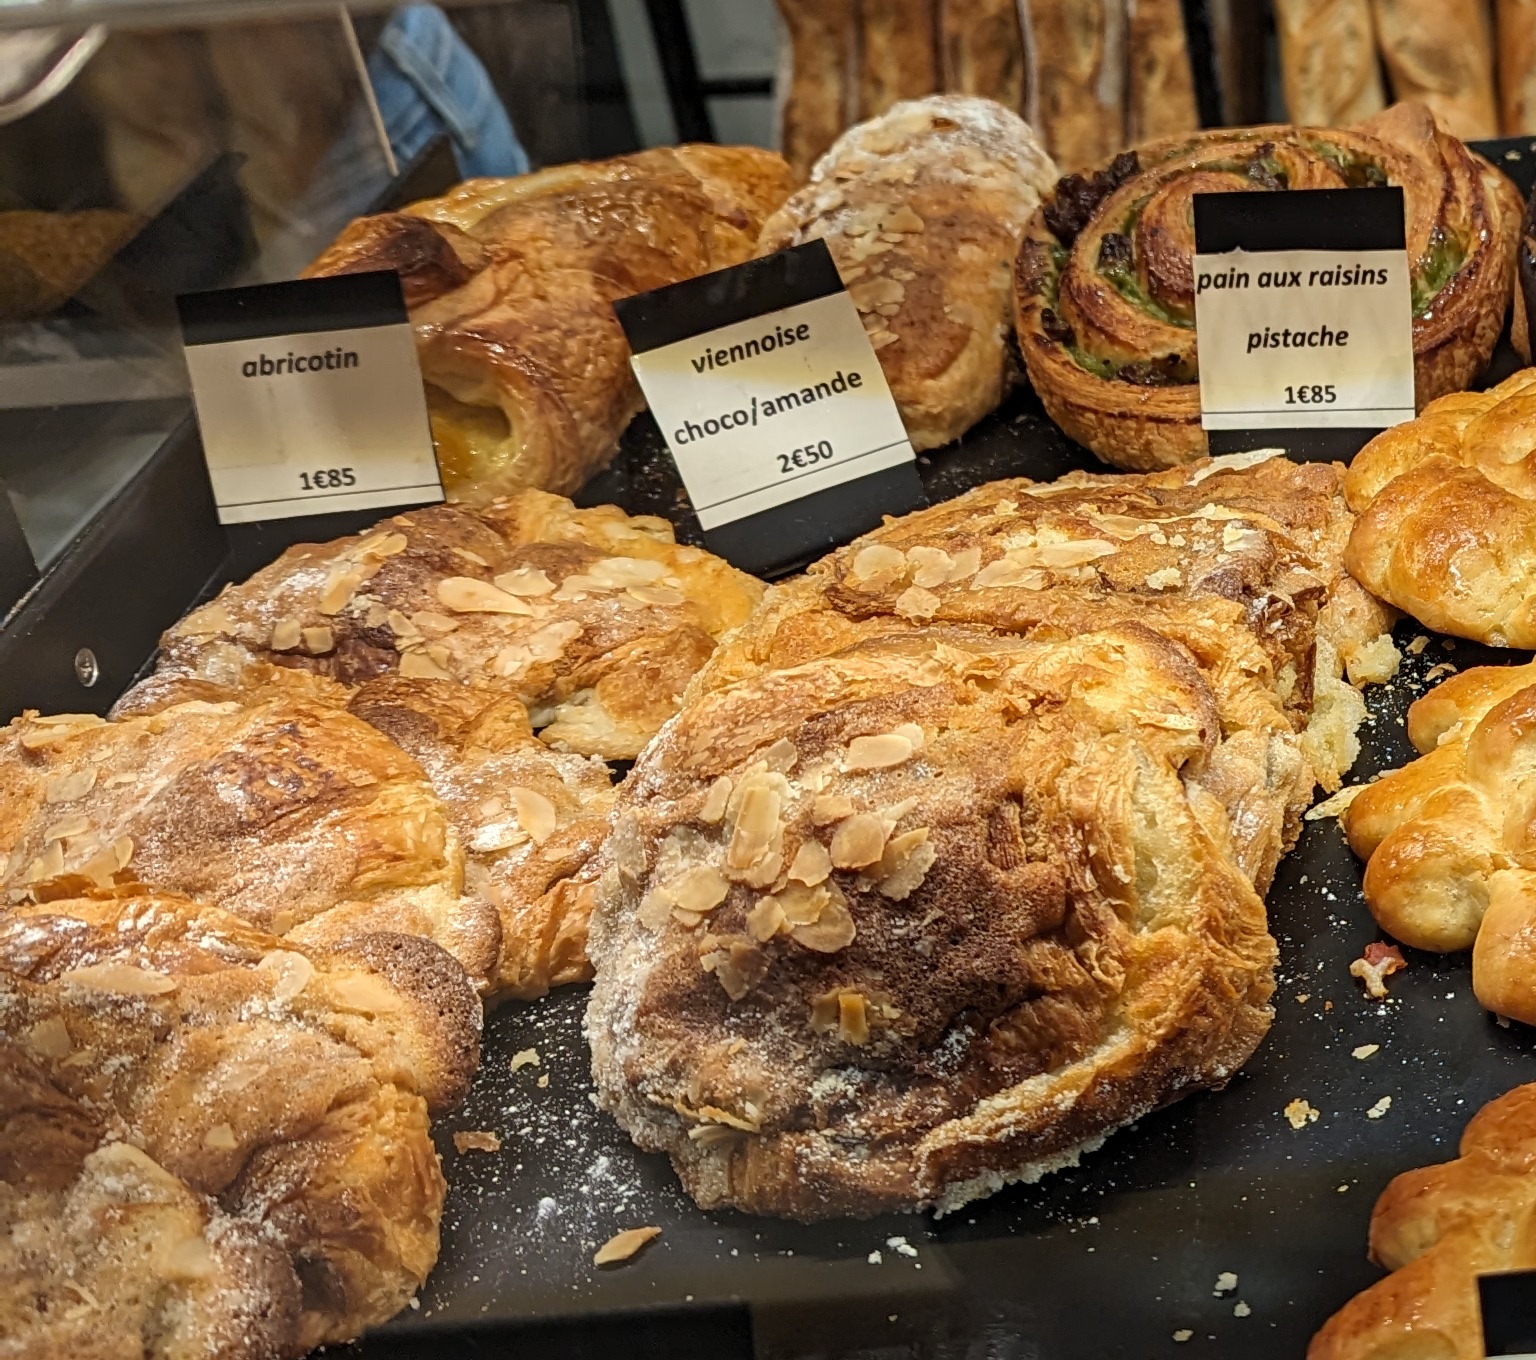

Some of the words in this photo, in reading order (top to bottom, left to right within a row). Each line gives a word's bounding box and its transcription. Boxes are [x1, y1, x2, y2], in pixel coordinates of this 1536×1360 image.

[1197, 266, 1250, 295] pain
[1257, 270, 1303, 290] aux
[1308, 262, 1389, 288] raisins
[690, 319, 811, 375] viennoise
[1246, 323, 1350, 355] pistache
[241, 346, 360, 379] abricotin
[673, 367, 864, 447] choco/amande
[1284, 383, 1338, 405] 1€85
[776, 439, 835, 475] 2€50
[299, 466, 357, 491] 1€85
